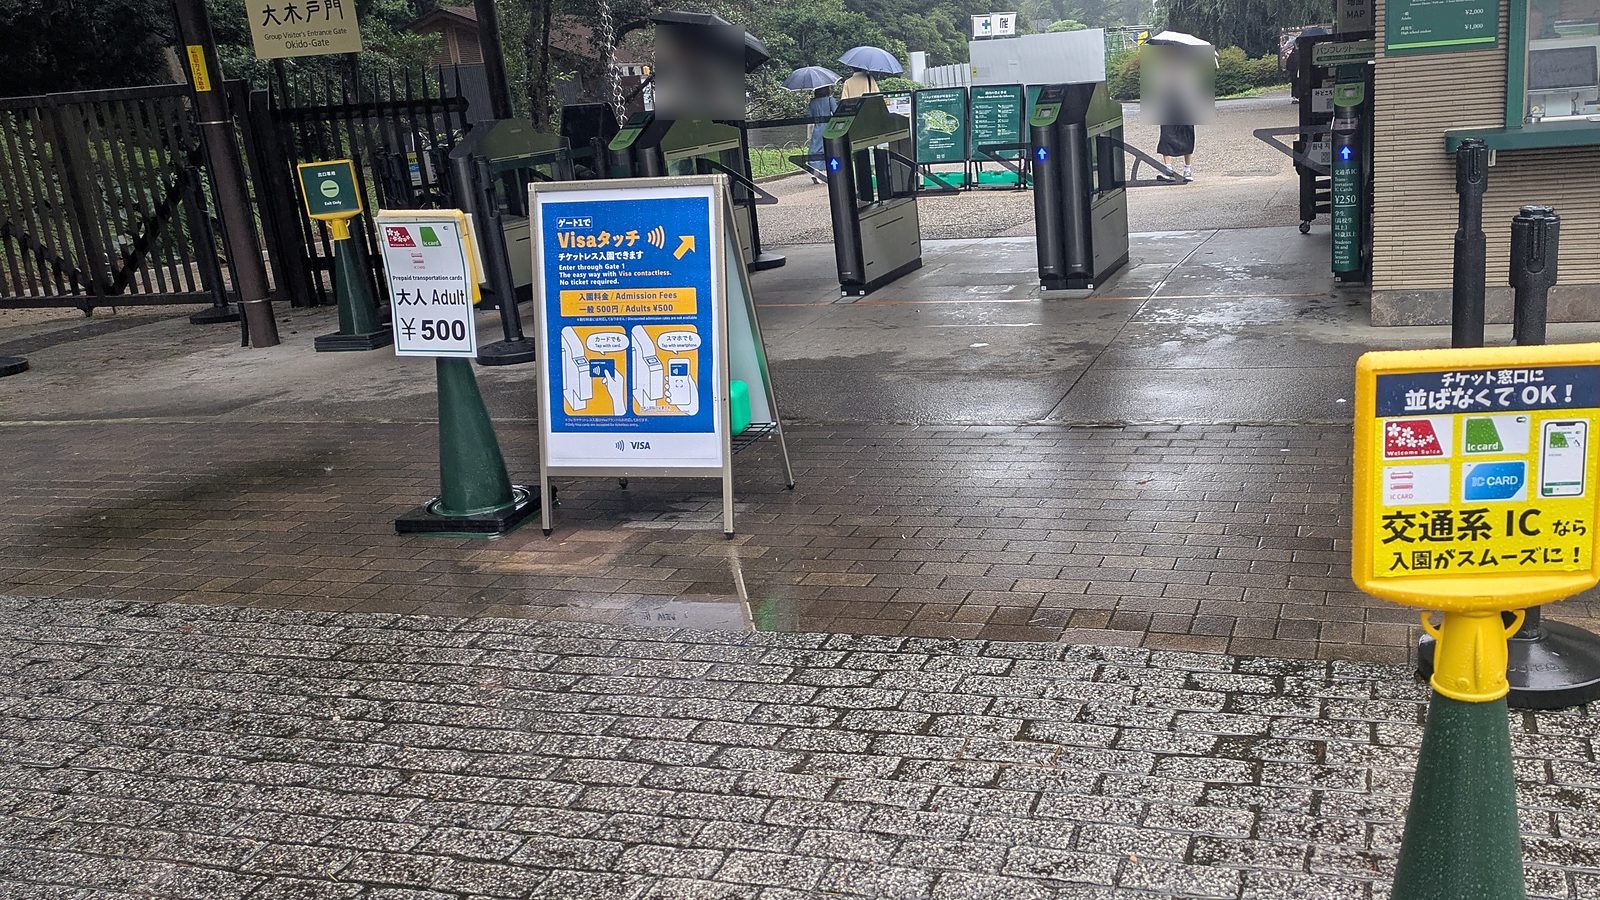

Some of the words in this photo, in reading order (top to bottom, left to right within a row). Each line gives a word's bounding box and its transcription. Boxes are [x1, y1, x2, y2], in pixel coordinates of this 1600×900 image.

[262, 0, 343, 26] 大木戸門
[1347, 10, 1365, 19] MAP
[264, 33, 282, 42] Group
[284, 31, 306, 39] Visitor's
[285, 39, 329, 49] Okido-Gate
[1335, 195, 1356, 204] ¥250
[558, 218, 591, 227] ゲート1で
[557, 230, 640, 248] Visaタッチ
[558, 250, 644, 262] チケットレス入園できます
[396, 288, 427, 306] 大人
[432, 289, 465, 305] Adult
[579, 292, 608, 301] 入園料金
[579, 306, 594, 314] 一般
[1441, 369, 1544, 387] チケット窓口に
[1476, 442, 1498, 450] card
[1472, 477, 1485, 487] IC
[1486, 476, 1518, 486] CARD
